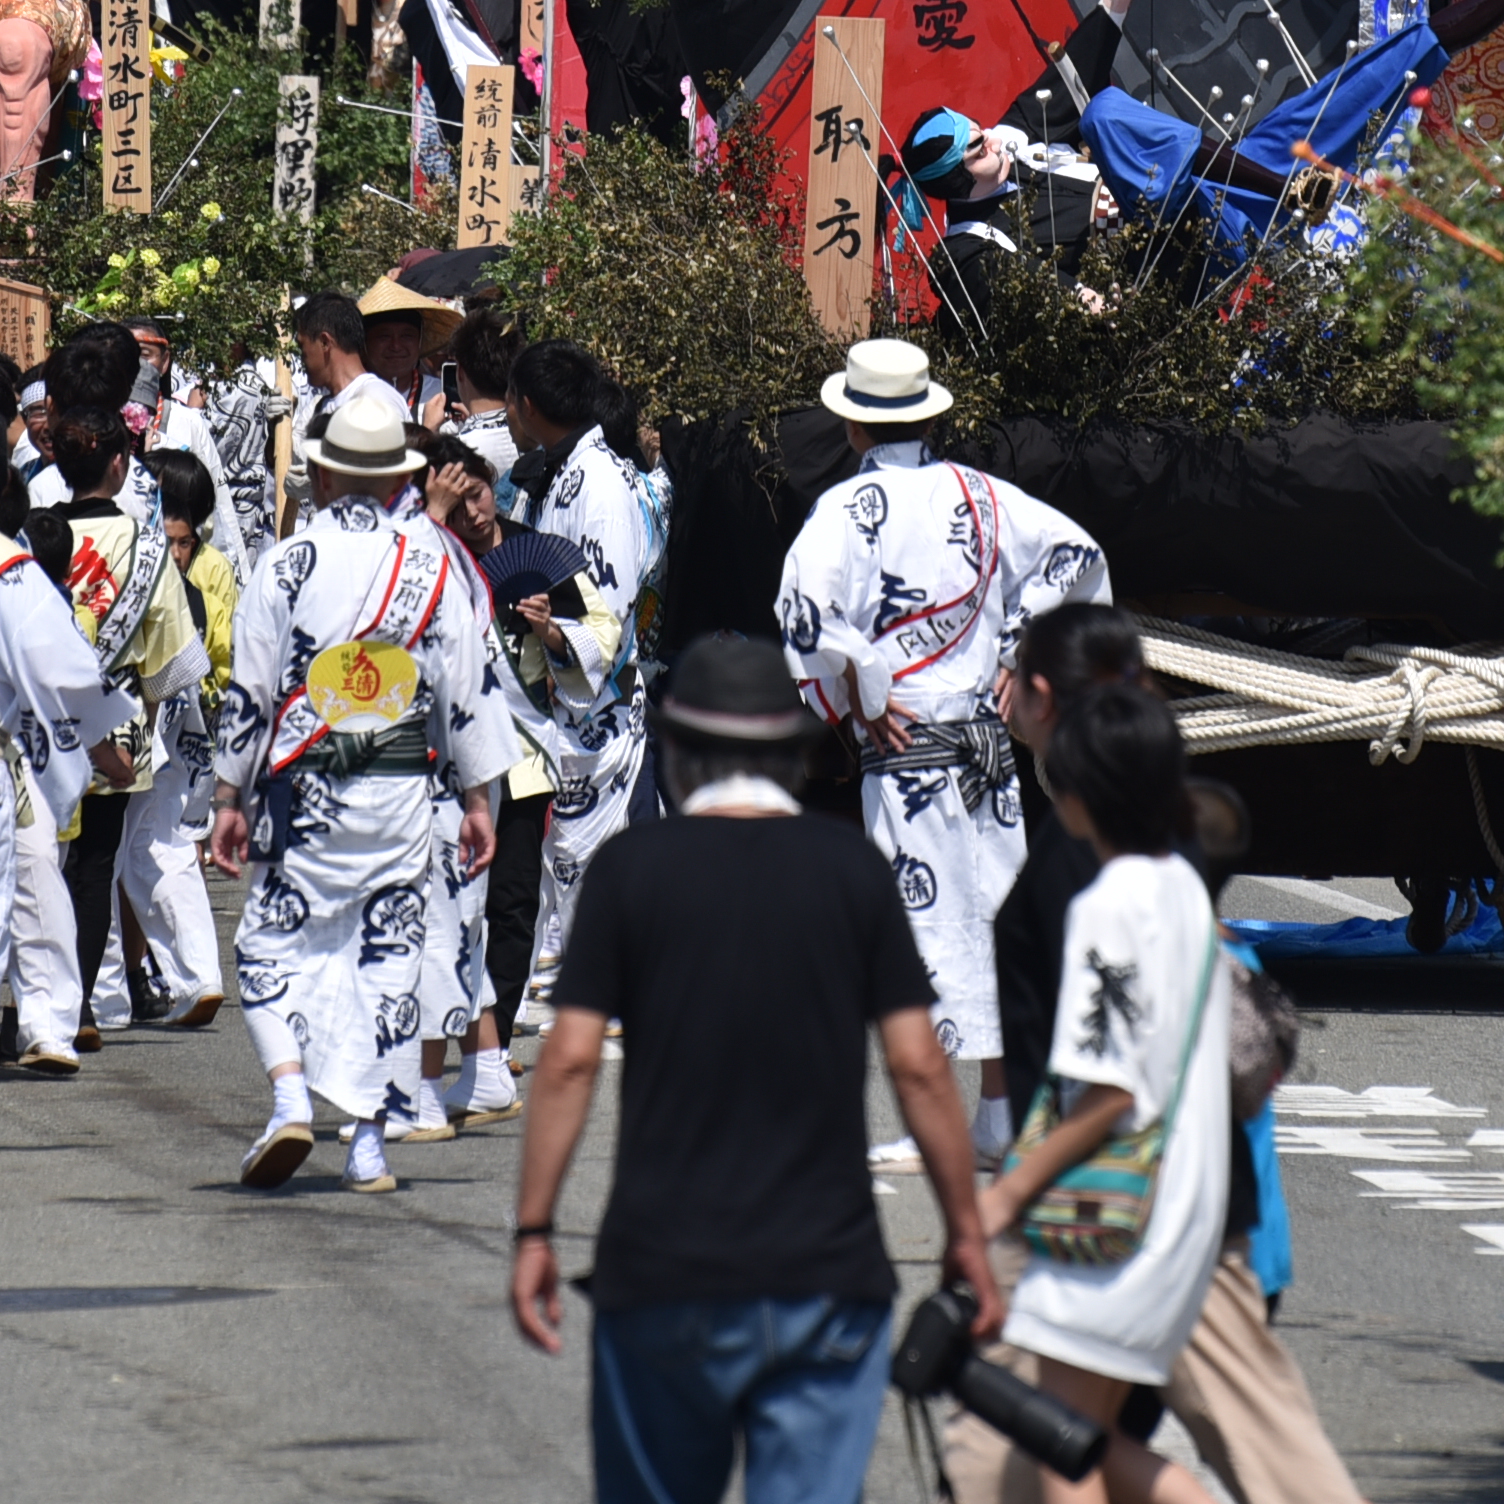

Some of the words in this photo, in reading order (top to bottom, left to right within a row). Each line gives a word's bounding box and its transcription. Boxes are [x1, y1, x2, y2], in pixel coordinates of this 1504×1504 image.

[465, 78, 503, 245] 統前清水町
[813, 106, 872, 259] 取方
